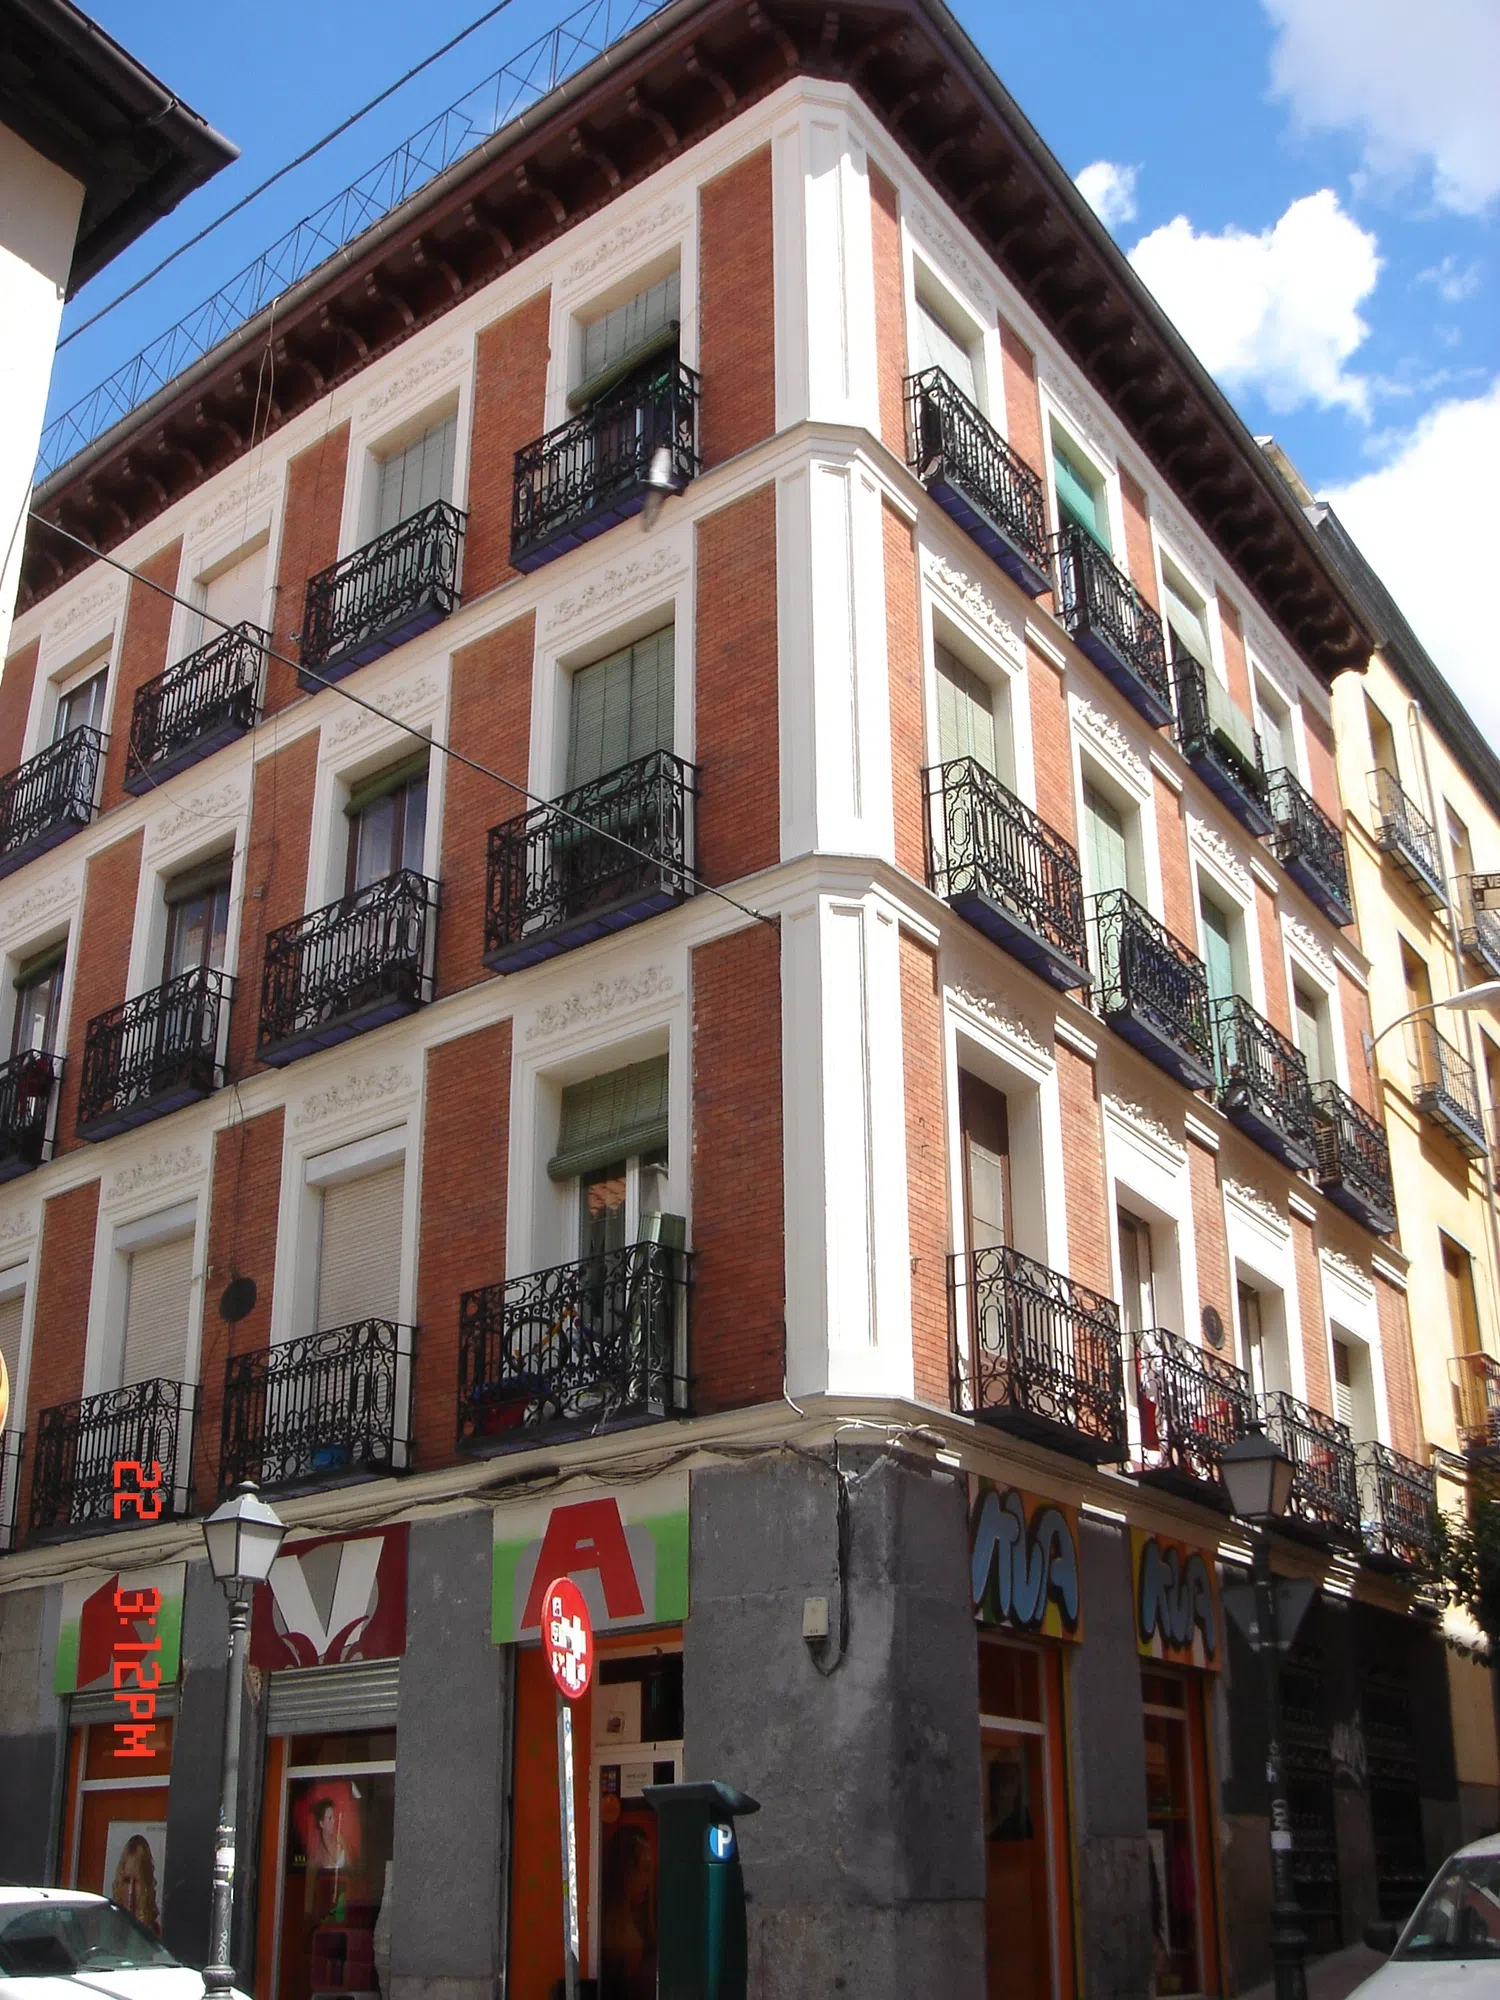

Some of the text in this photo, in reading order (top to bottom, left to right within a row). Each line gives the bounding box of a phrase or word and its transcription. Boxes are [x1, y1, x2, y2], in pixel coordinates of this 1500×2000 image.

[267, 1536, 385, 1656] V
[520, 1497, 645, 1629] A
[718, 1824, 733, 1857] P
